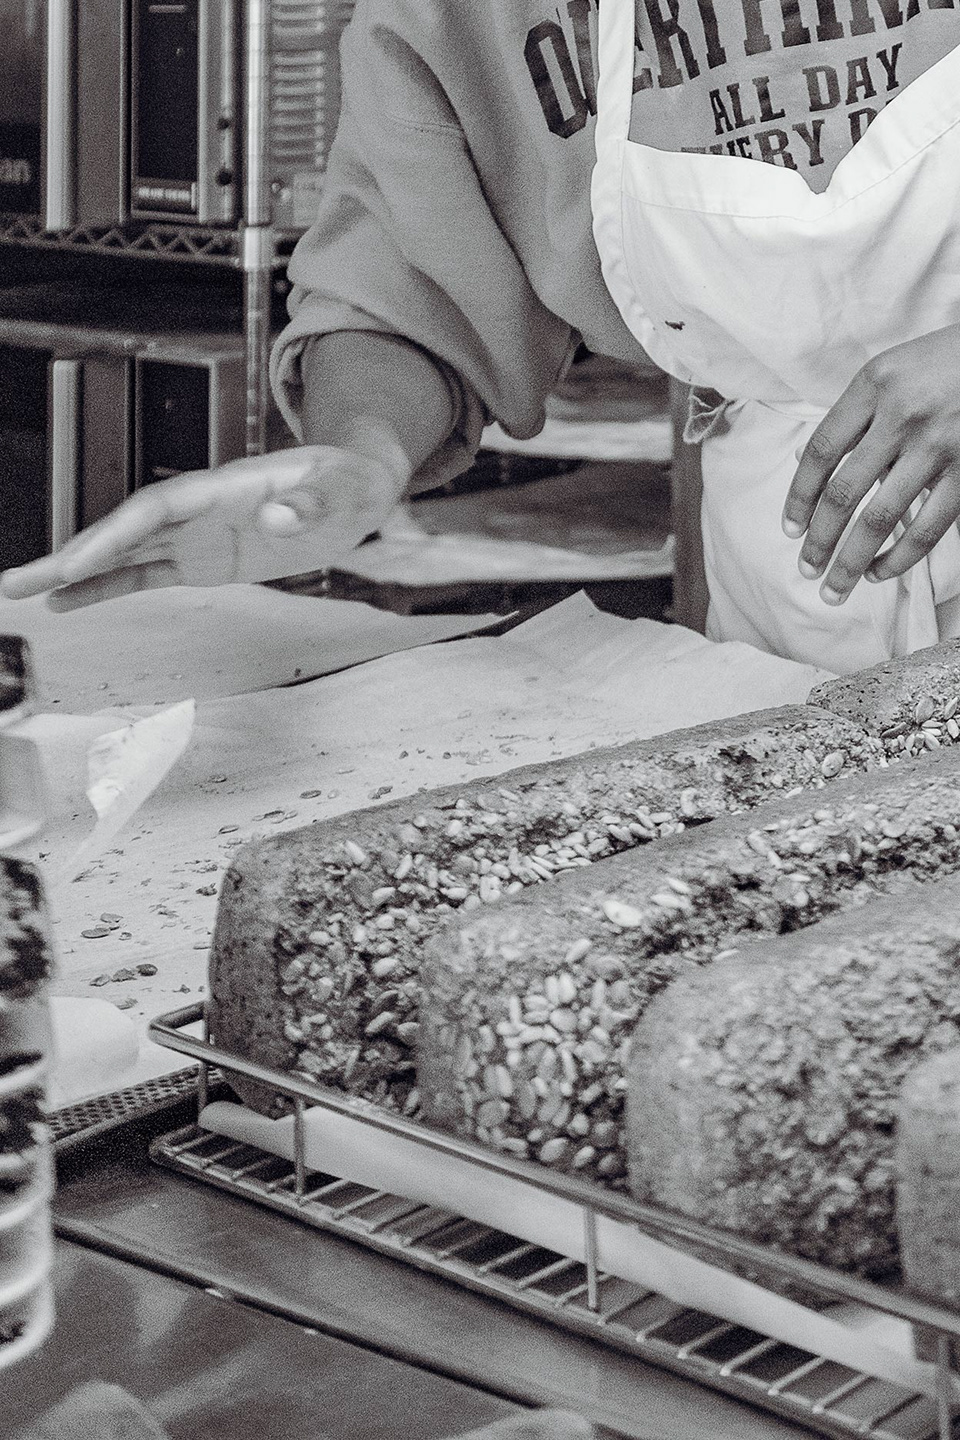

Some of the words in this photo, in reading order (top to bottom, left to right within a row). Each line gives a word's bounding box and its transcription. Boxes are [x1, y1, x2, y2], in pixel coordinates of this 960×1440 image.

[709, 76, 786, 135] ALL
[802, 42, 903, 112] DAY
[681, 119, 825, 170] ERY
